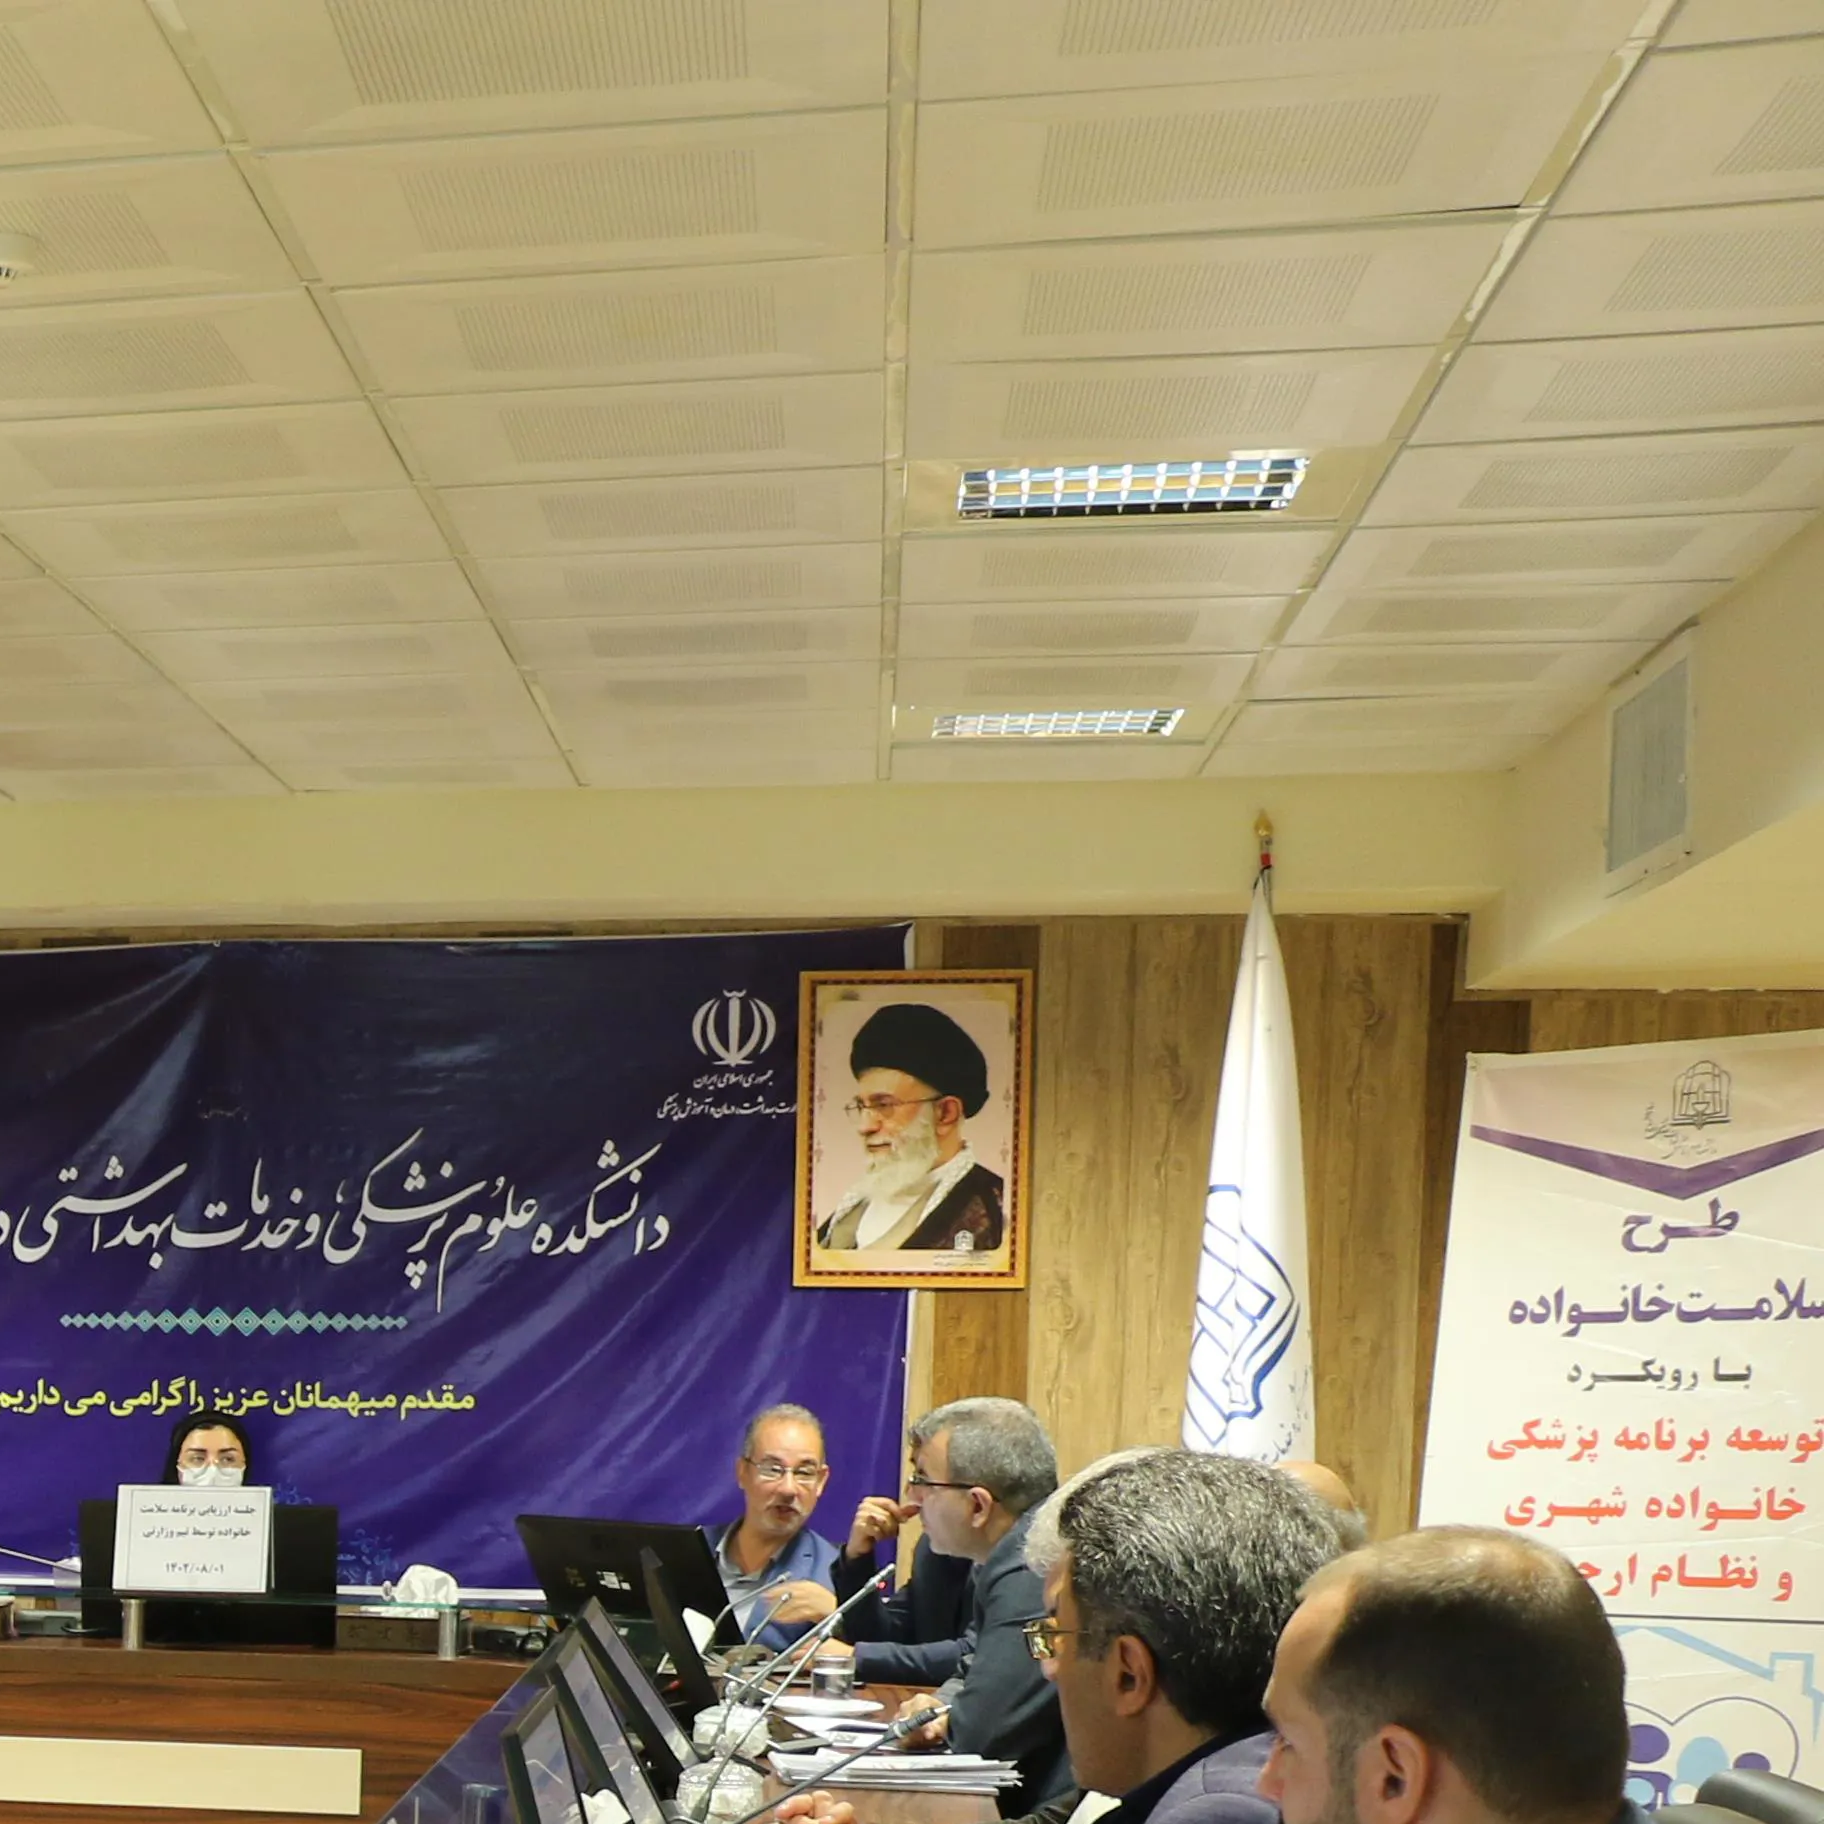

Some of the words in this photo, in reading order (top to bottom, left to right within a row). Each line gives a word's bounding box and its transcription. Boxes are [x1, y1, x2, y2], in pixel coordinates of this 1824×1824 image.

[11, 1154, 188, 1270] بهداشتی
[169, 1156, 304, 1252] خدمات
[322, 1127, 488, 1290] پزشکی
[529, 1138, 671, 1257] دانشکده
[295, 1211, 321, 1250] و
[1620, 1196, 1741, 1254] طرح
[1566, 1357, 1699, 1392] رویکرد
[1712, 1356, 1753, 1390] با
[63, 1388, 107, 1418] می
[108, 1375, 187, 1418] گرامی
[188, 1379, 205, 1415] را
[213, 1387, 270, 1416] عزیز
[272, 1380, 397, 1418] میهمانان
[400, 1383, 476, 1423] مقدم
[1486, 1416, 1600, 1463] پزشکی
[1612, 1416, 1711, 1463] برنامه
[1725, 1416, 1824, 1464] توسعه
[1503, 1486, 1628, 1529] شهری
[1645, 1485, 1807, 1532] خانواده
[1650, 1552, 1760, 1599] نظام
[1771, 1567, 1794, 1602] و
